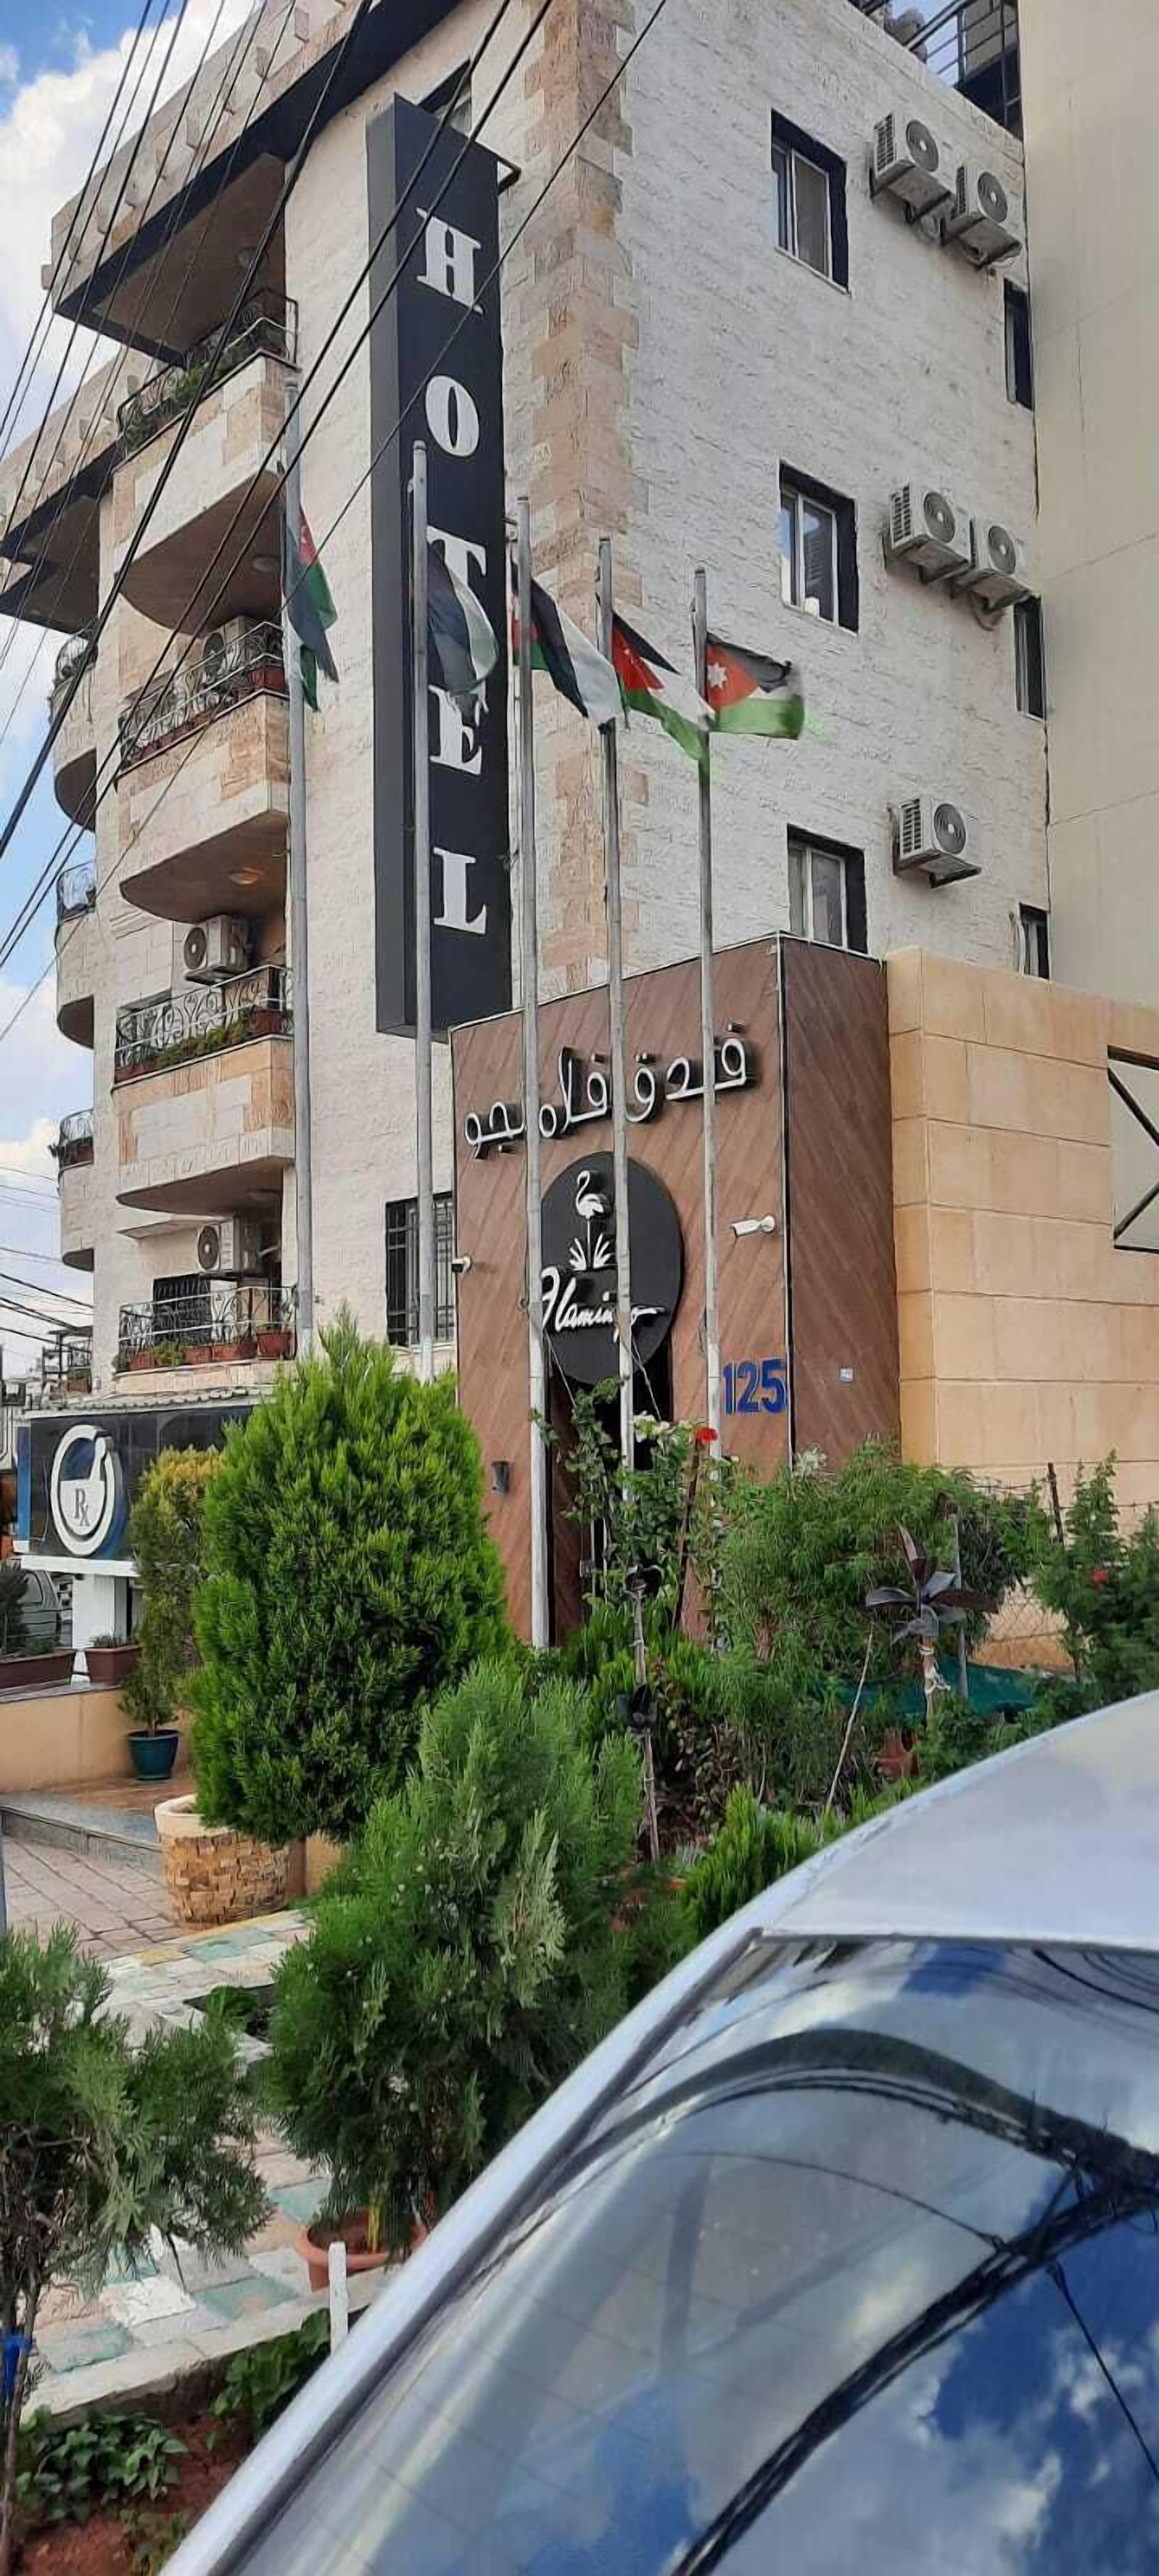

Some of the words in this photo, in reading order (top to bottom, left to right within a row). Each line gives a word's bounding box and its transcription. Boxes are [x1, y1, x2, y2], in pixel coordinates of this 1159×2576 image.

[625, 1023, 747, 1122] فدق
[541, 1266, 658, 1342] Flamino
[723, 1358, 786, 1414] 125
